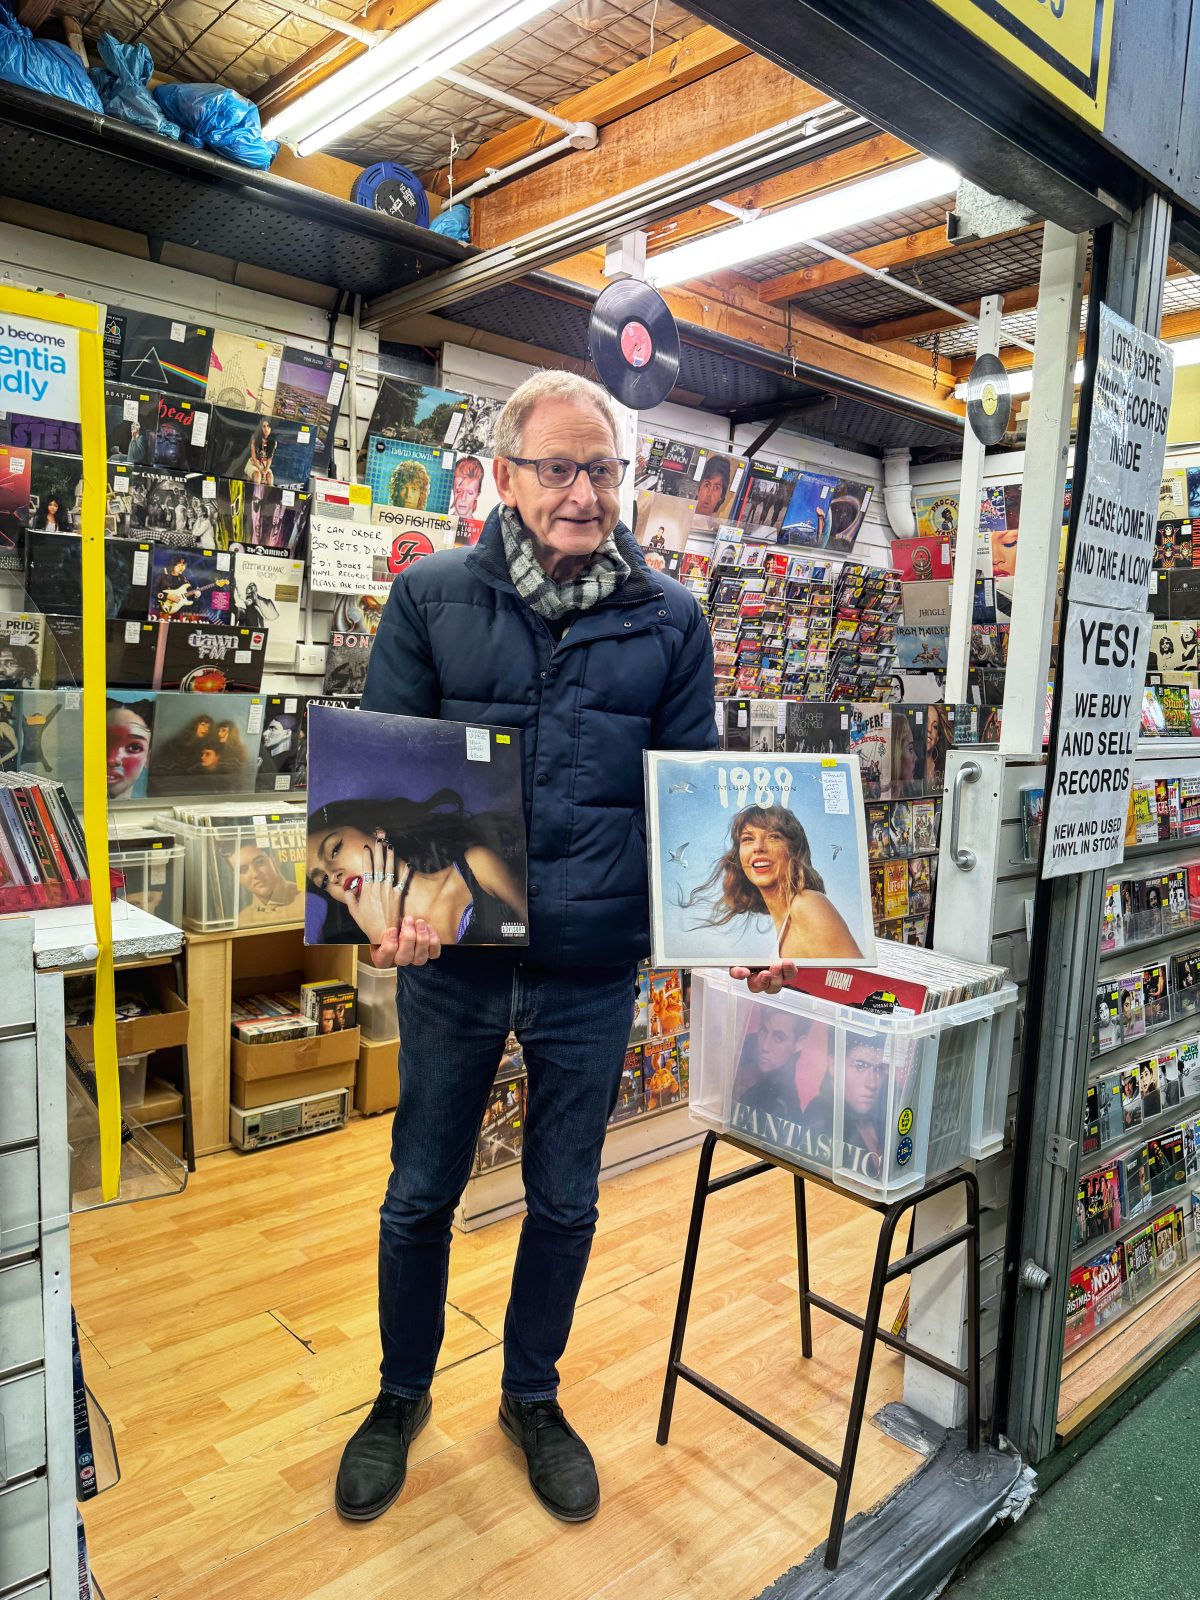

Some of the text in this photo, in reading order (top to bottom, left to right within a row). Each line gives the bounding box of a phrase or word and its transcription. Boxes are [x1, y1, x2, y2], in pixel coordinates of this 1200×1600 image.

[8, 325, 66, 348] become
[0, 344, 66, 374] entia
[1112, 328, 1162, 386] LOTS MORE
[0, 369, 48, 402] dly
[158, 398, 196, 426] head
[1110, 436, 1142, 472] INSIDE
[142, 472, 159, 480] LANA
[161, 474, 176, 482] DEL
[378, 512, 452, 531] FOO FIGHTERS
[1084, 493, 1154, 543] PLEASE COME IN
[326, 526, 344, 534] CAN
[352, 529, 382, 540] ORDER
[338, 571, 370, 581] RECORDS
[1074, 542, 1150, 587] AND TAKE A LOOK
[312, 579, 336, 588] PLEASE
[6, 620, 40, 630] PRIDE
[896, 626, 917, 637] IRON
[28, 631, 40, 644] 2
[332, 633, 370, 648] BON
[1080, 618, 1139, 668] YES!
[1075, 692, 1132, 718] WE BUY
[1061, 731, 1132, 757] AND SELL
[718, 766, 793, 810] 1989
[1057, 768, 1130, 796] RECORDS
[1054, 818, 1122, 841] NEW AND USED
[290, 848, 306, 861] BAC
[1052, 835, 1119, 859] VINYL IN STOCK
[825, 970, 854, 992] WHAM!
[1180, 1052, 1198, 1062] SCOTT
[731, 1102, 883, 1180] FANTASTIC
[1092, 1262, 1118, 1292] NOW
[1066, 1291, 1091, 1314] RISTMAS
